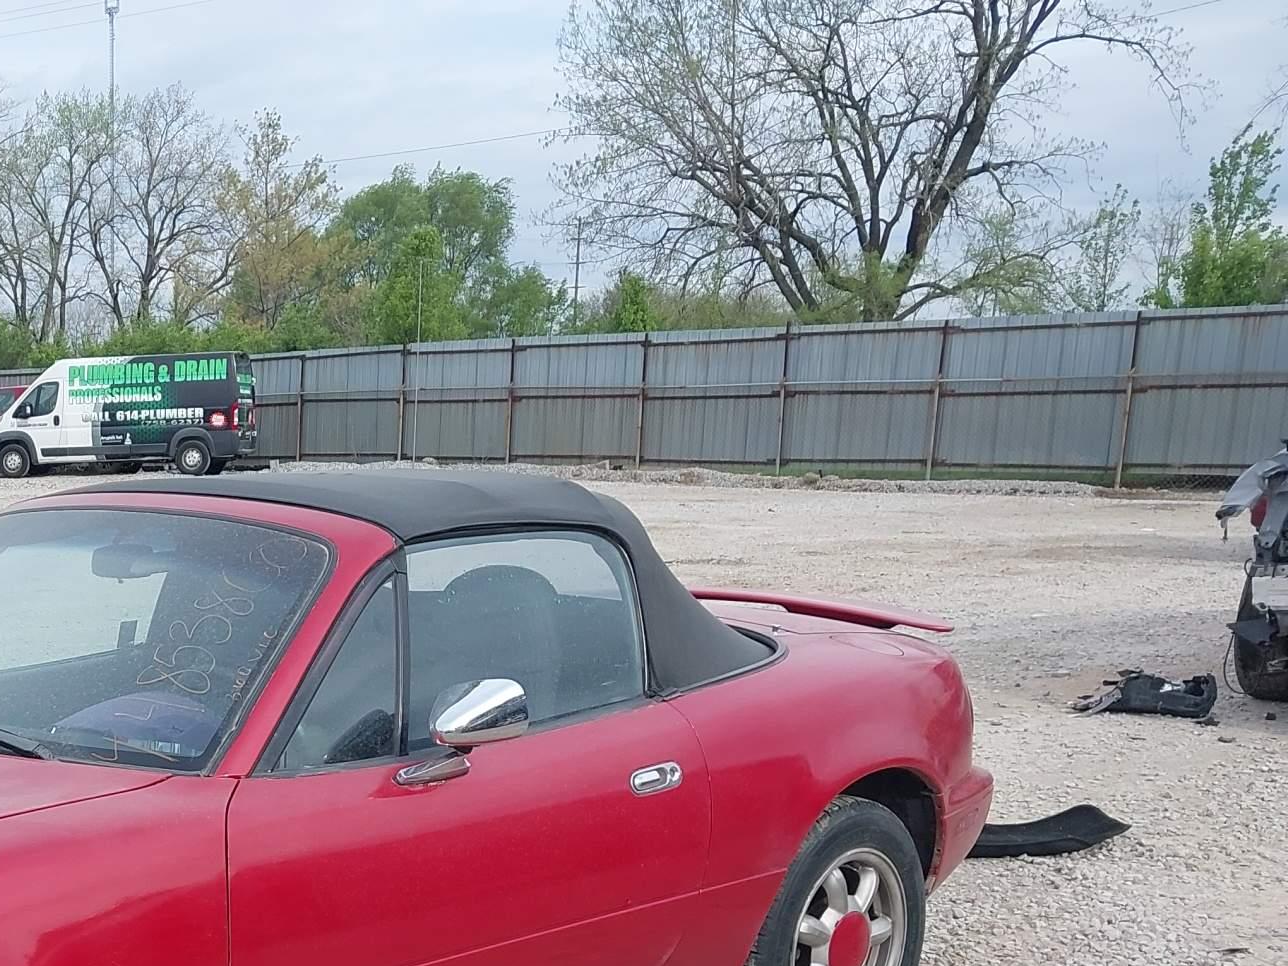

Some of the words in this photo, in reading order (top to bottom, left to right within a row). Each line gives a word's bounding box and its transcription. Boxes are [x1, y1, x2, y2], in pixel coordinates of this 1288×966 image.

[68, 362, 155, 387] PLUMBING
[158, 365, 170, 382] &
[174, 358, 227, 382] DRAIN
[68, 386, 162, 404] PROFESSIONALS
[80, 411, 111, 423] CALL
[116, 407, 204, 421] 614-PLUMBER
